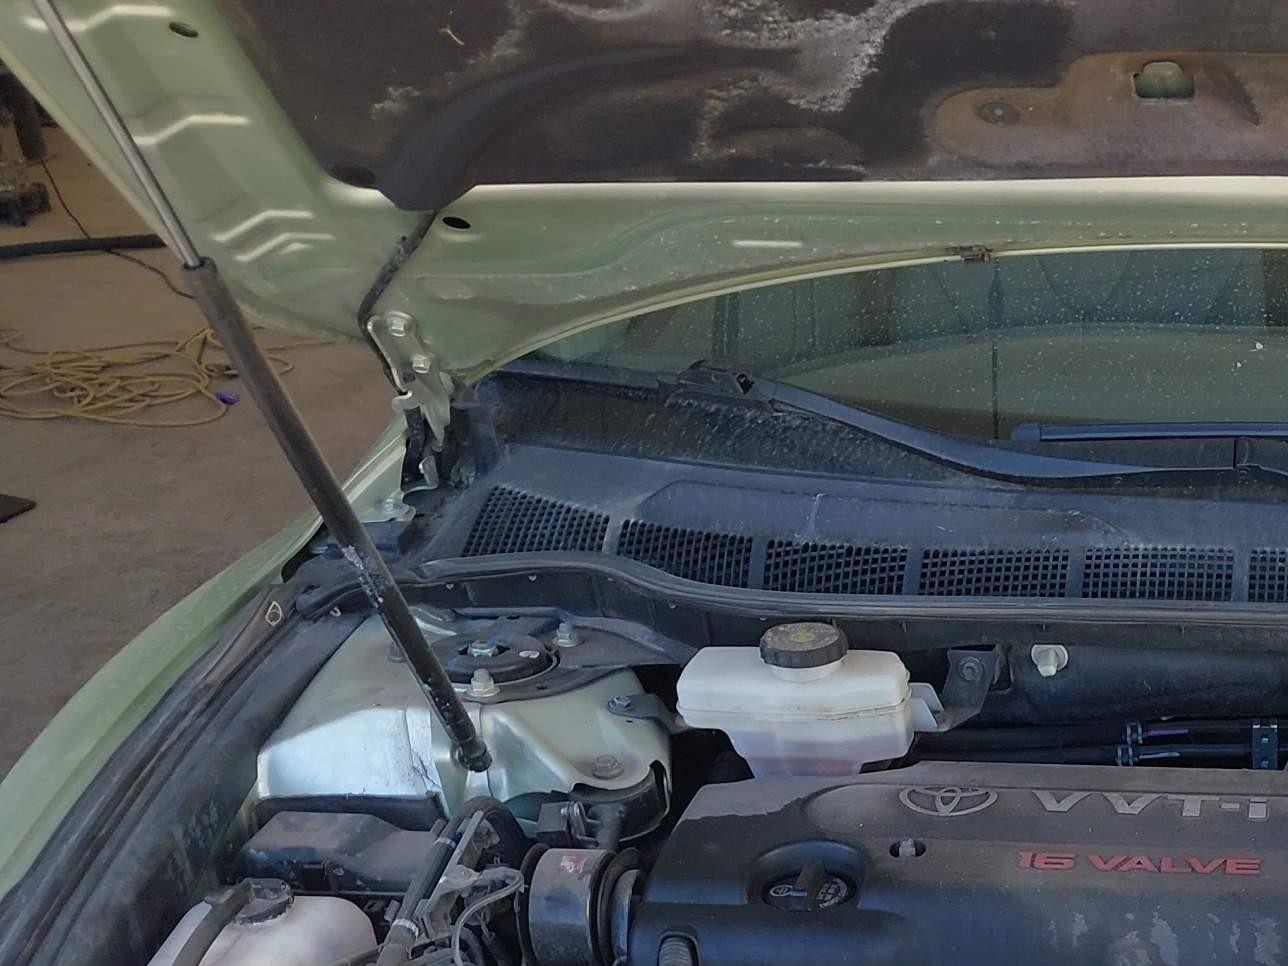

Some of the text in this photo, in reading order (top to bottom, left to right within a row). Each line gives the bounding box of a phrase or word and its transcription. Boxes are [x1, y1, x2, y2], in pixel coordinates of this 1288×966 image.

[1032, 791, 1268, 819] VVT-i
[1018, 851, 1261, 875] 16 VALVE
